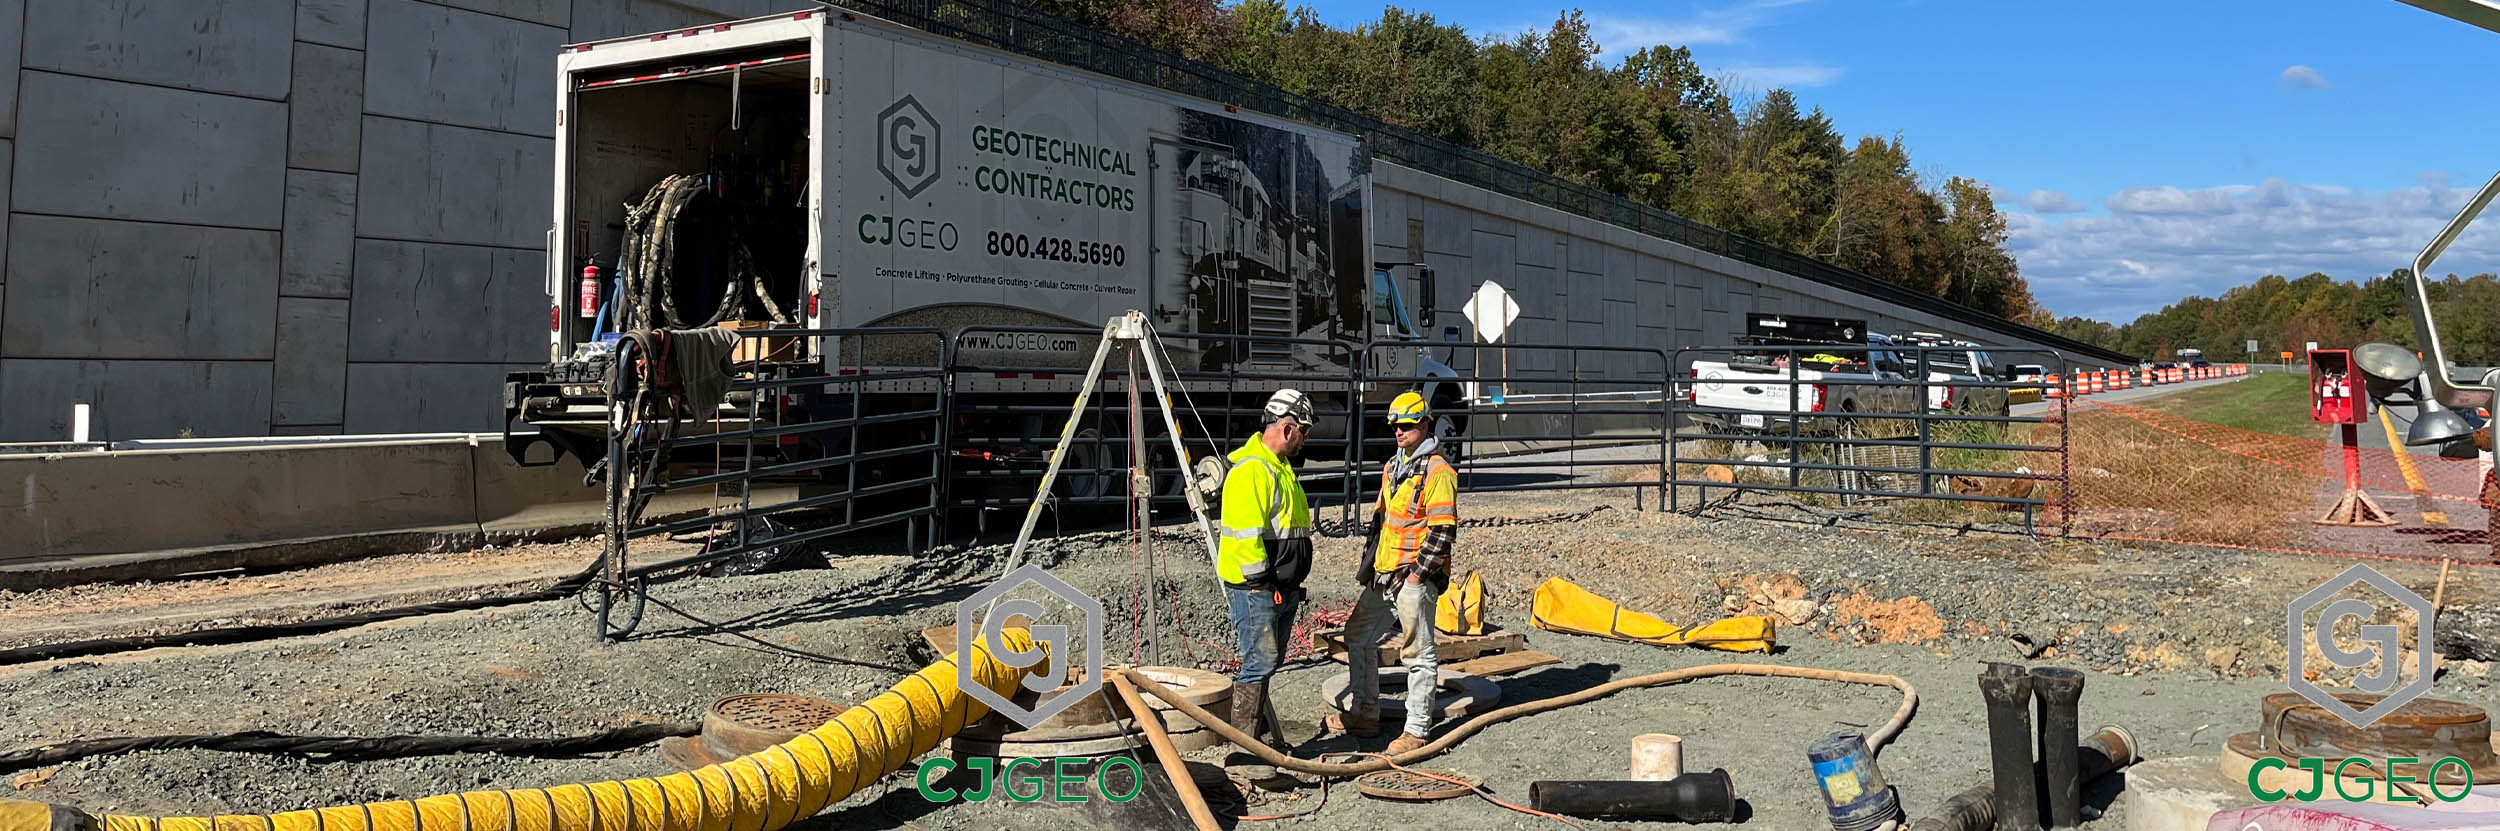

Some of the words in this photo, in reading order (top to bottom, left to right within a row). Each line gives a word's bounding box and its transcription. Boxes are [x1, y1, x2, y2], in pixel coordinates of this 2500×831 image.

[972, 125, 1136, 176] GEOTECHNICAL
[975, 166, 1134, 212] CONTRACTORS
[858, 213, 958, 251] CJGEO
[987, 231, 1125, 267] 800.428.5690
[582, 286, 597, 294] FIRE
[875, 267, 912, 279] Concrete
[914, 269, 940, 282] Lifting
[946, 272, 996, 284] Polyurethane
[997, 276, 1028, 288] Grouting
[1034, 279, 1059, 289] Cellular
[1060, 281, 1089, 292] Concrete
[1094, 284, 1116, 294] Culvert
[1117, 286, 1137, 296] Repair
[958, 332, 1077, 352] www.CJGEO.com
